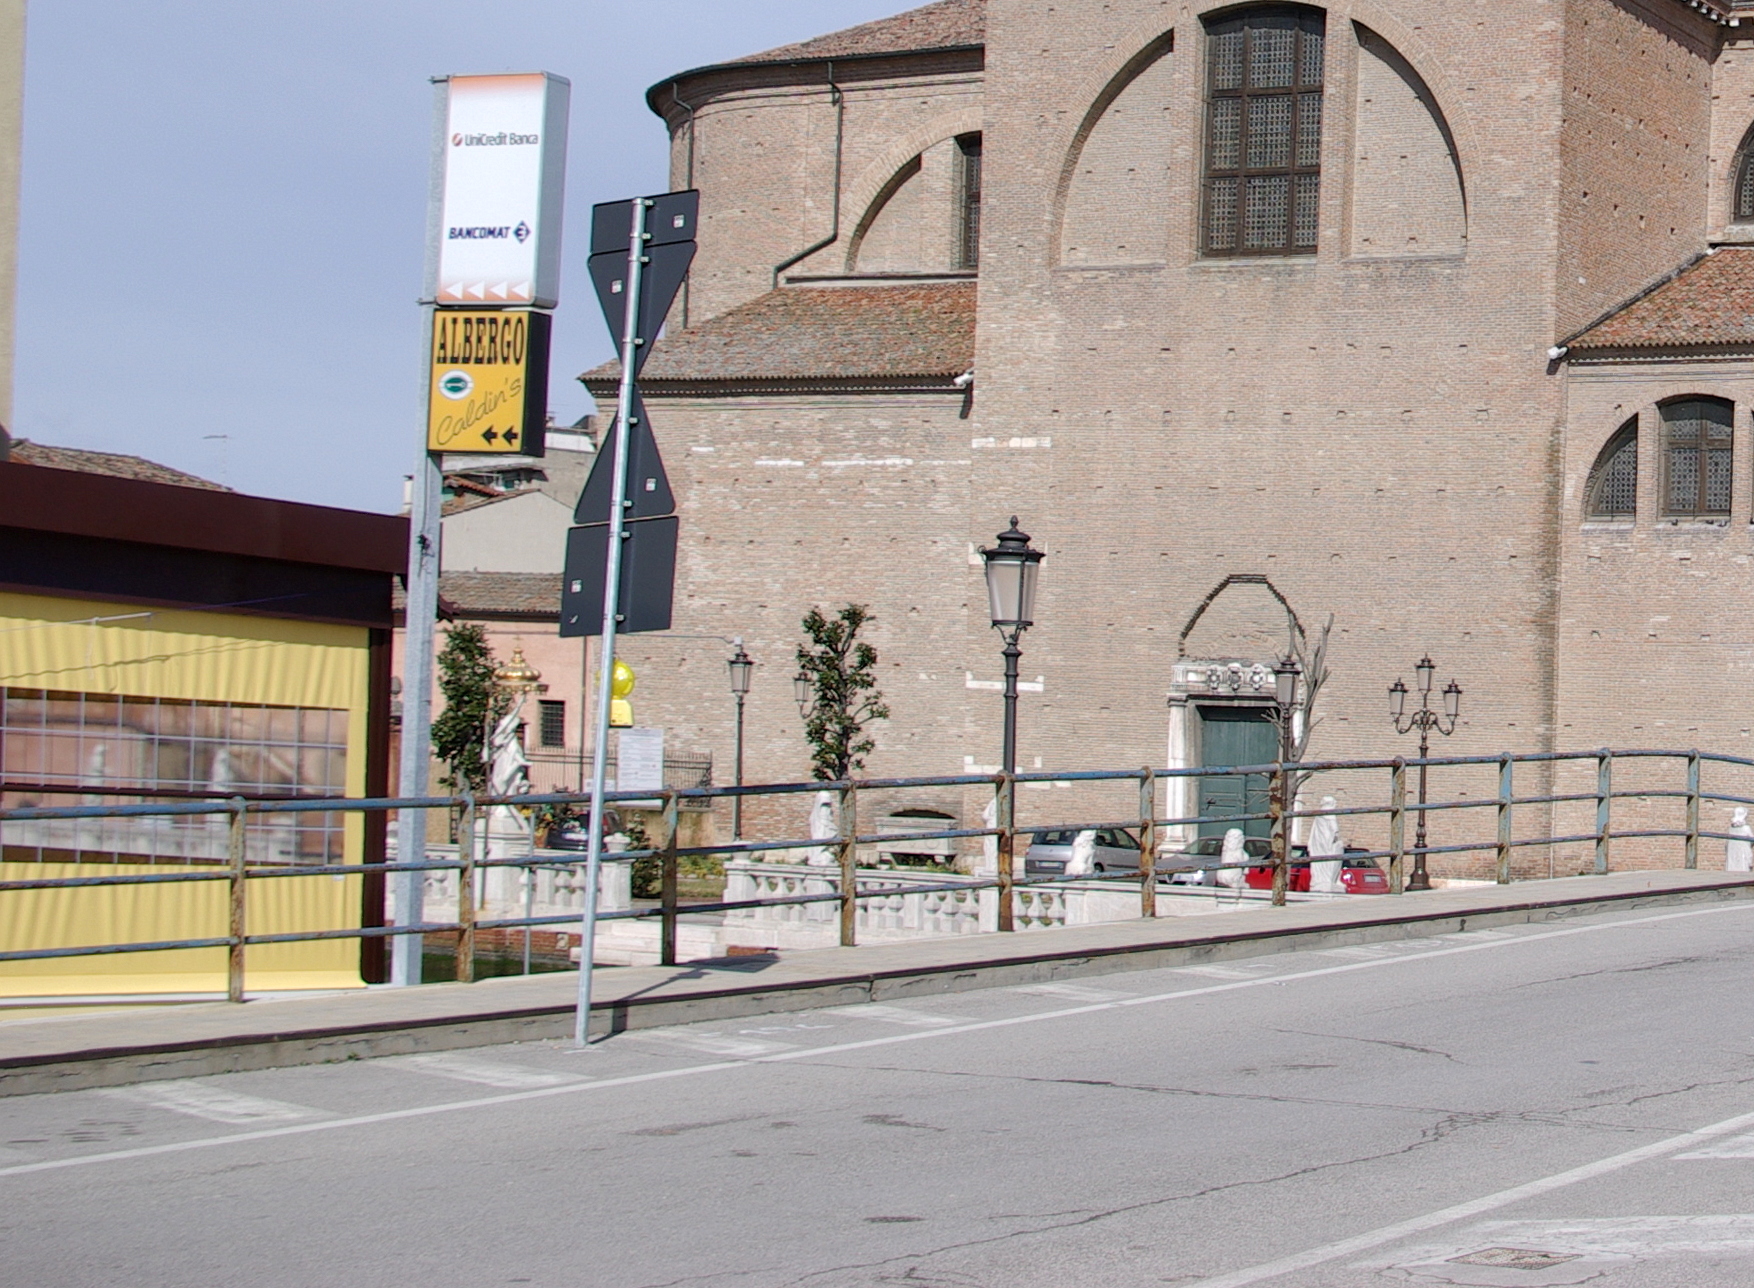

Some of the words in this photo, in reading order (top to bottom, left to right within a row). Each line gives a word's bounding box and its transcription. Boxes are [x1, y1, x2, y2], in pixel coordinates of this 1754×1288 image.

[465, 132, 507, 146] UniCredit
[509, 133, 538, 145] Banca
[449, 226, 511, 239] BANCOMAT
[436, 316, 525, 365] ALBERGO
[436, 377, 522, 445] Caldin's
